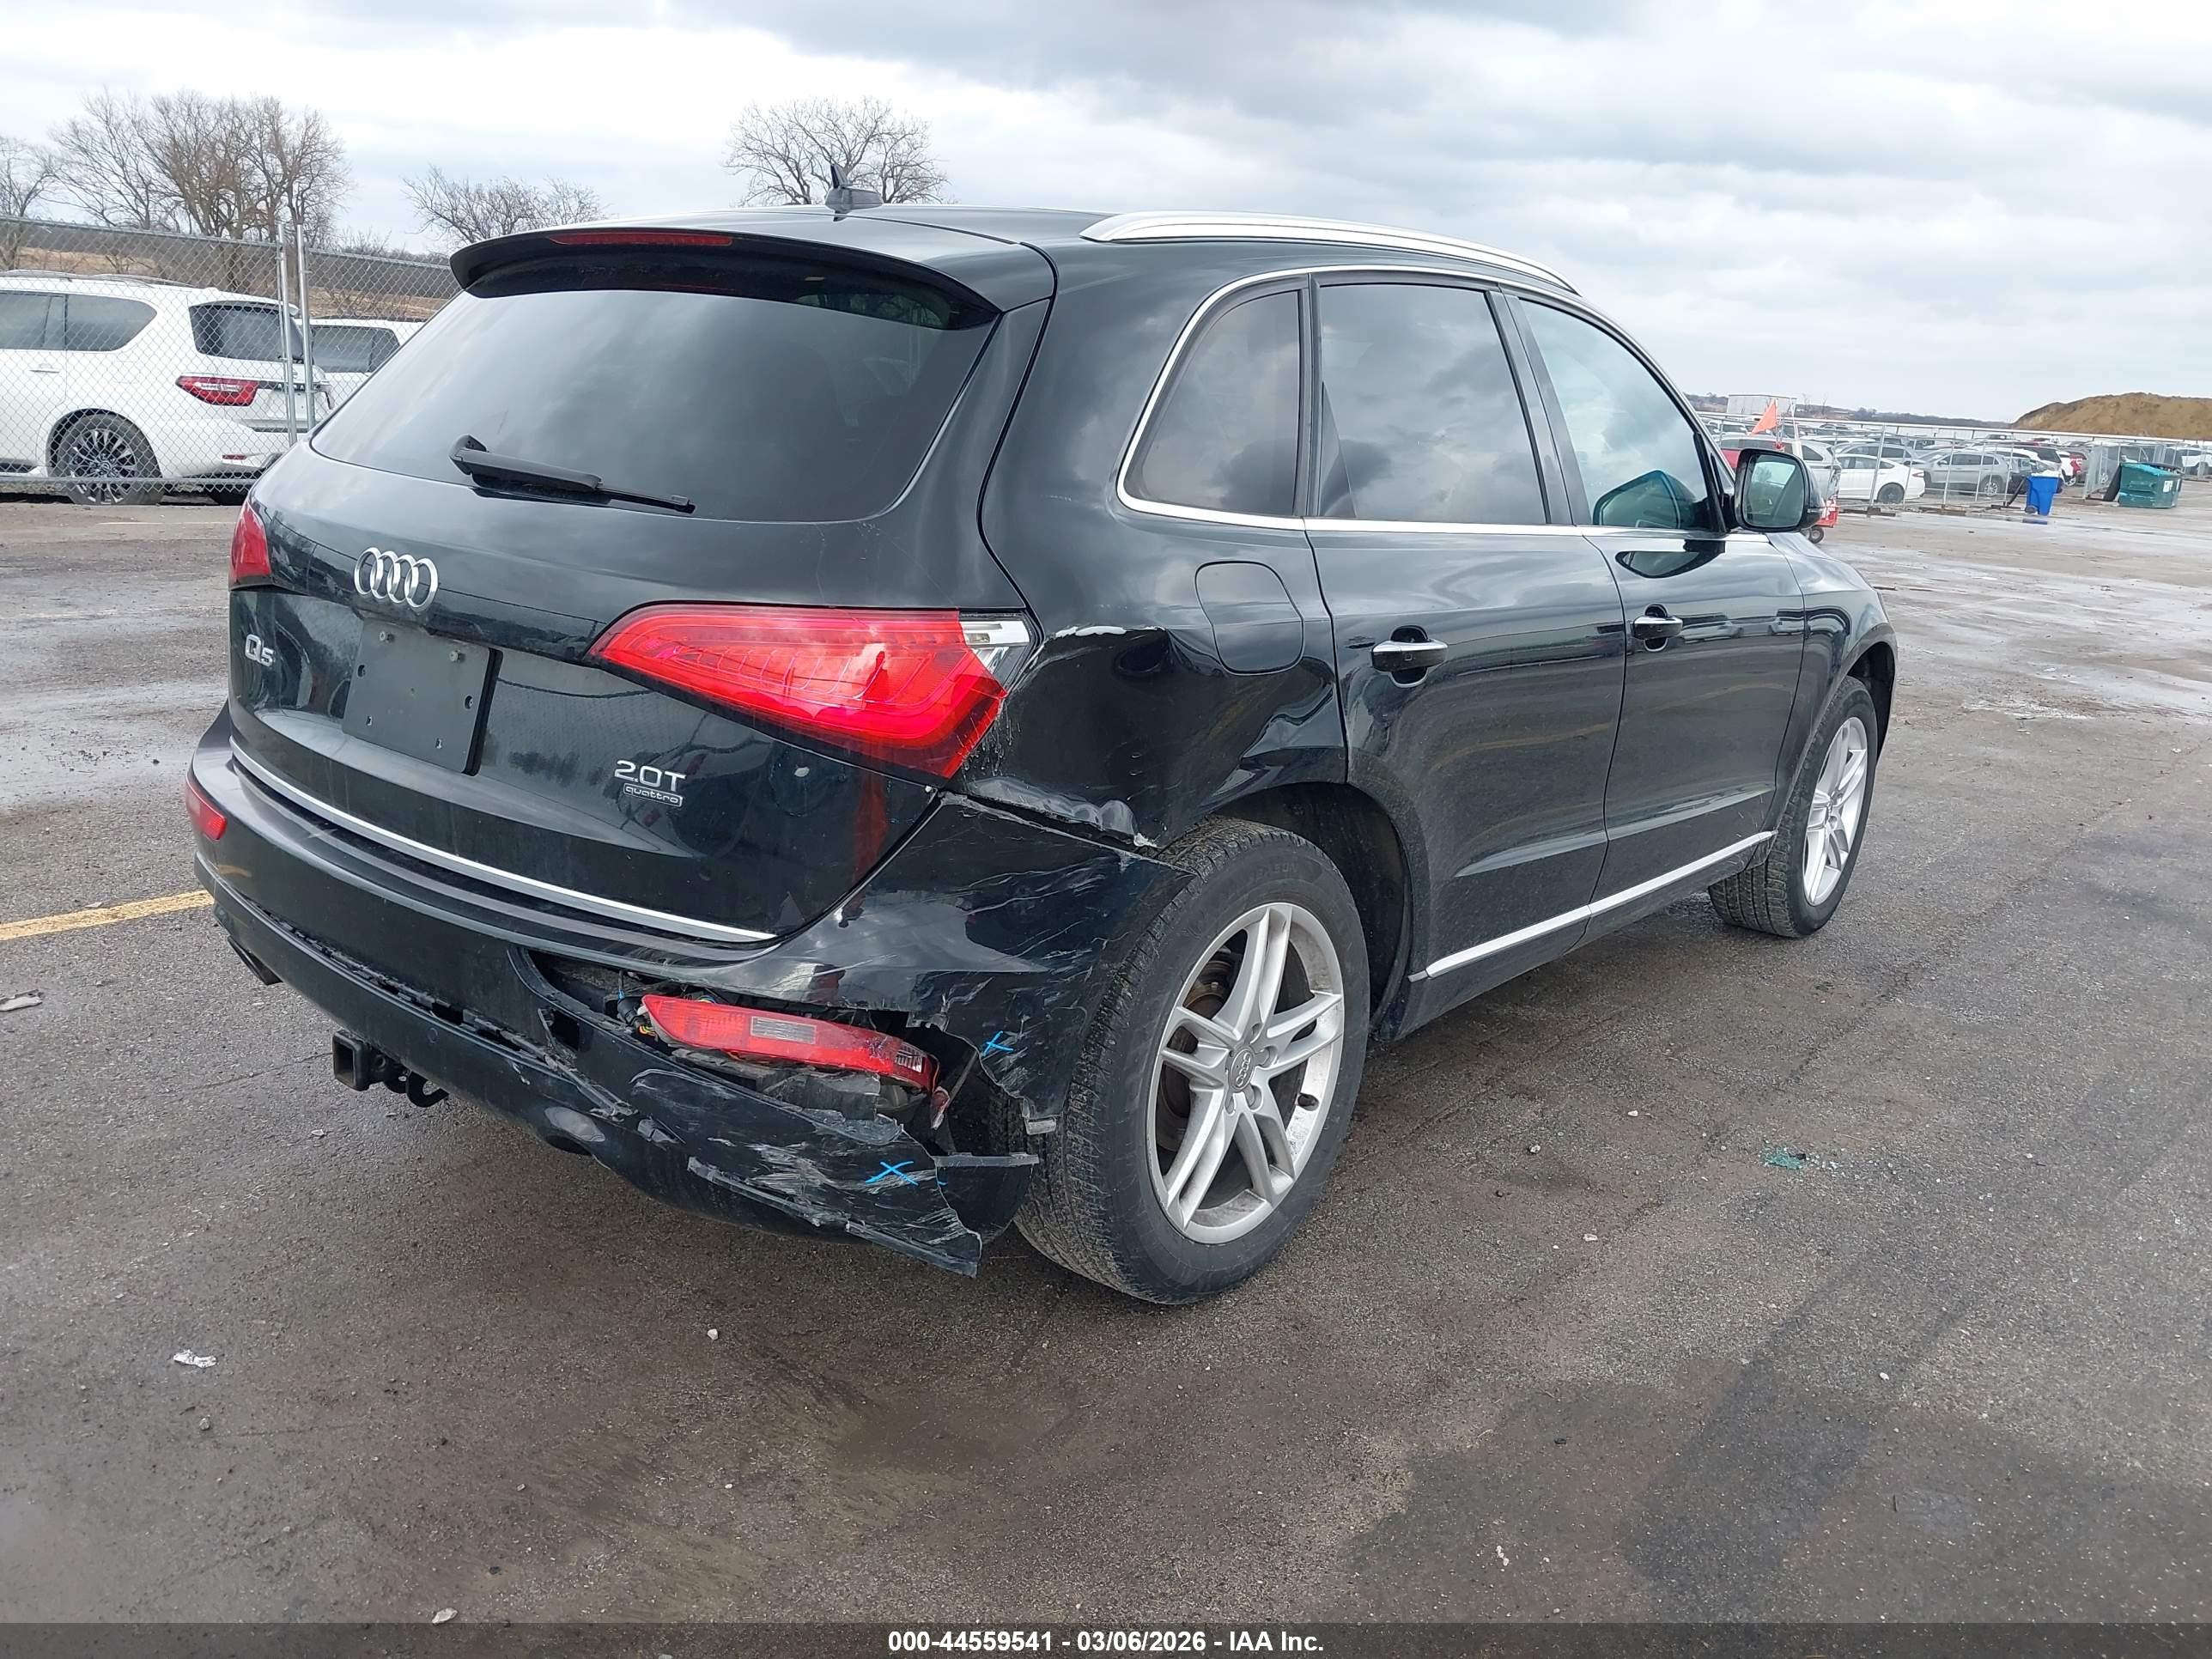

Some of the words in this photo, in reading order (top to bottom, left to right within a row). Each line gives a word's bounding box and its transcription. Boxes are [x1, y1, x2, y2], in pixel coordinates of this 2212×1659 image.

[245, 634, 275, 667] Q5
[614, 759, 687, 792] 2.0T
[624, 785, 680, 805] quattro
